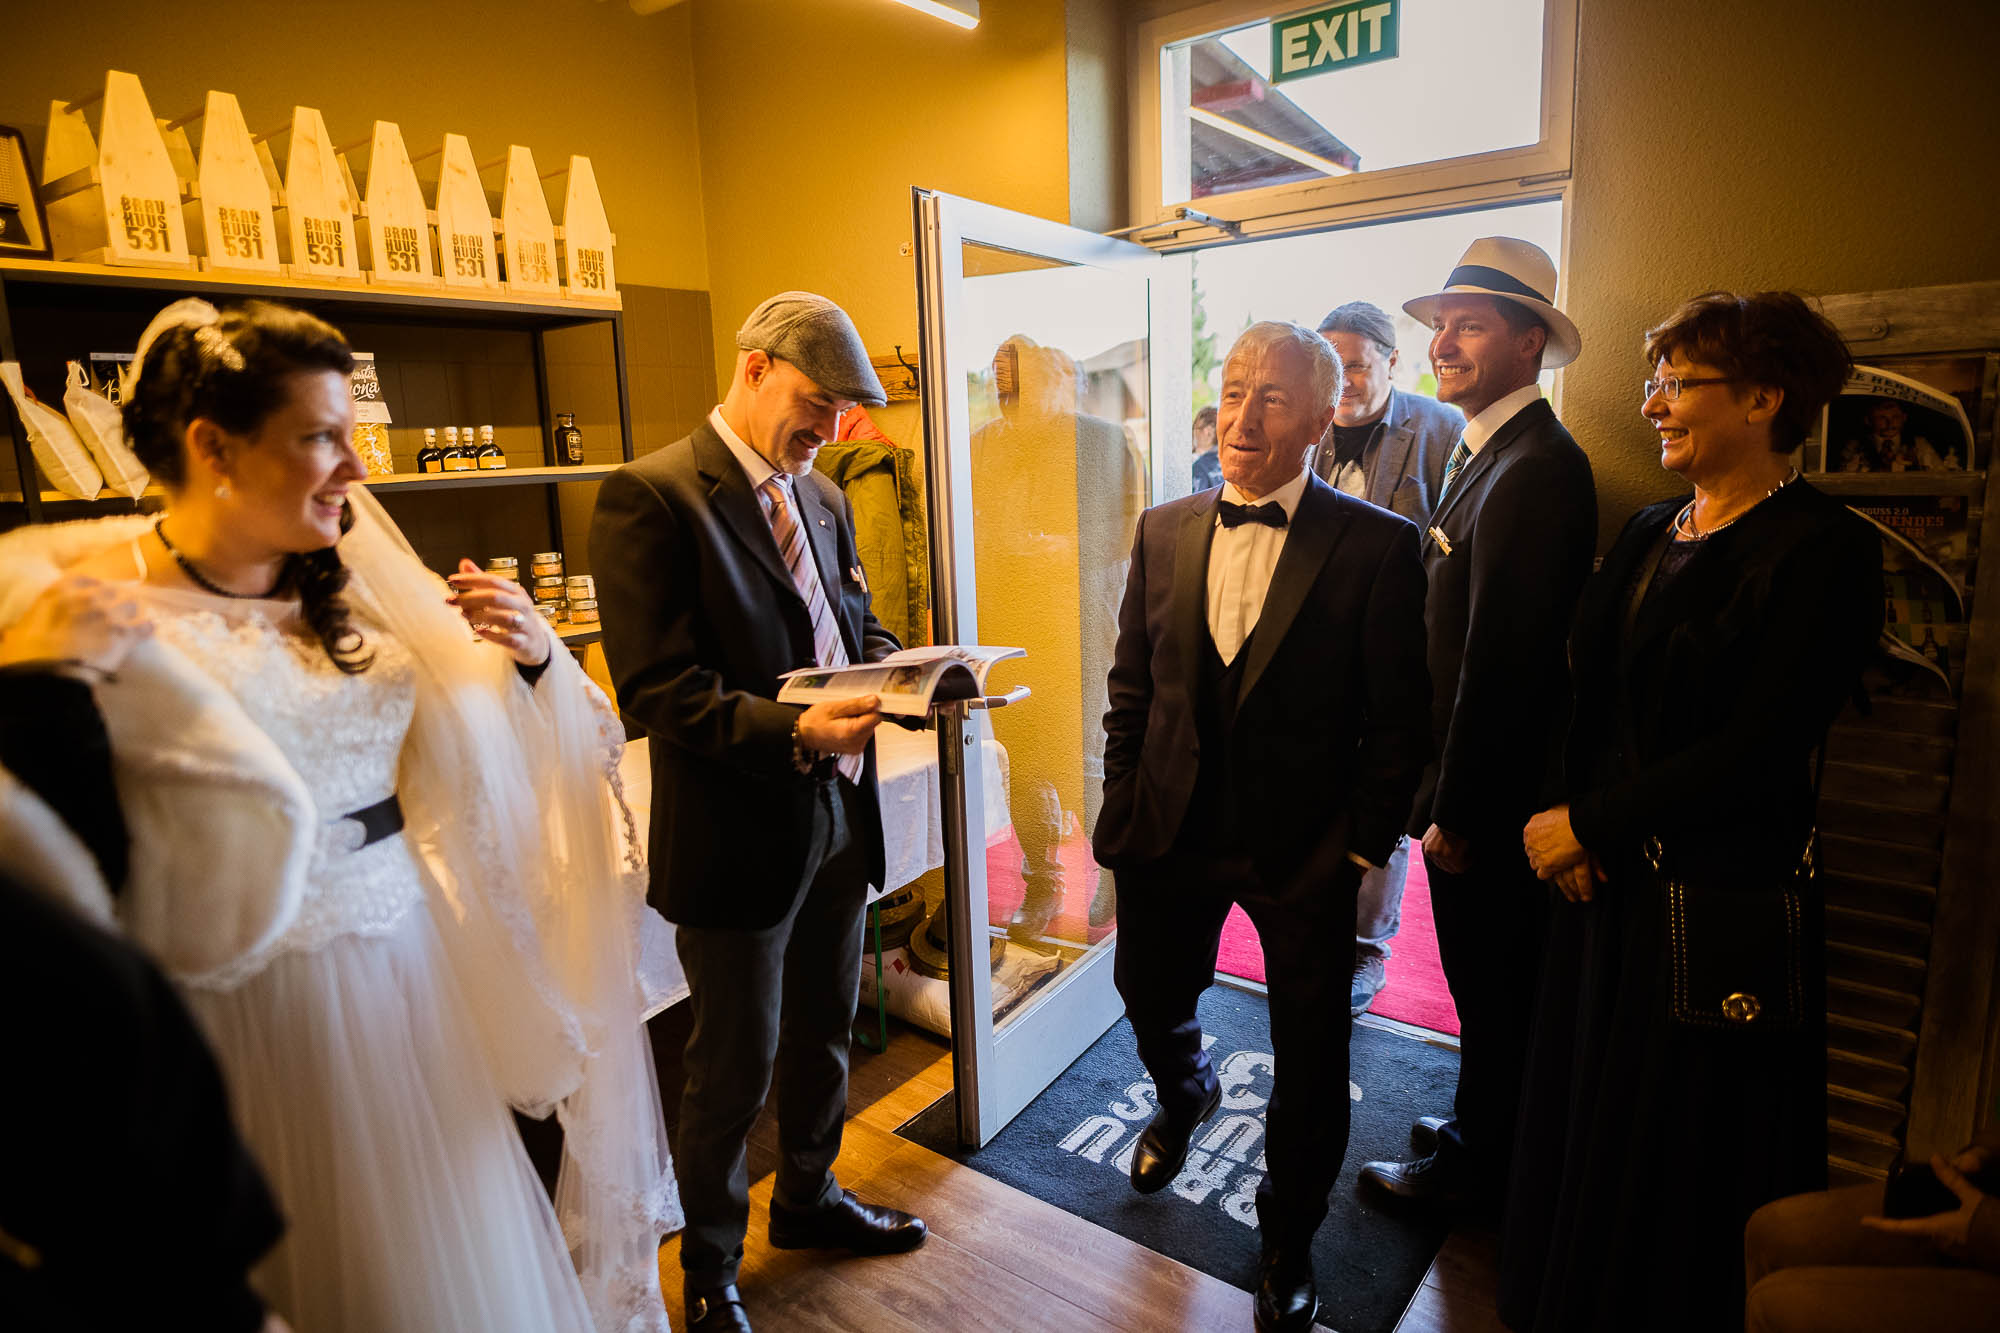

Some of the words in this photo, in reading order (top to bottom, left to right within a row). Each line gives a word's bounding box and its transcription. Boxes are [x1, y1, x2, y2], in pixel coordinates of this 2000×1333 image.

[1281, 2, 1391, 74] EXIT
[121, 194, 165, 214] BRAU
[123, 212, 167, 229] HUUS
[219, 207, 260, 224] BRAU
[221, 221, 261, 237] HUUS
[304, 217, 341, 233] BRAU
[384, 226, 417, 241] BRAU
[126, 227, 170, 252] 531
[223, 235, 264, 259] 531
[305, 231, 342, 246] HUUS
[385, 239, 418, 252] HUUS
[452, 233, 483, 247] BRAU
[308, 244, 344, 267] 531
[453, 246, 484, 259] HUUS
[578, 248, 604, 261] BRAU
[387, 251, 420, 273] 531
[455, 258, 486, 278] 531
[578, 260, 604, 272] HUUS
[520, 264, 549, 283] 531
[581, 271, 606, 290] 531
[352, 365, 377, 383] asta
[350, 381, 380, 401] ona
